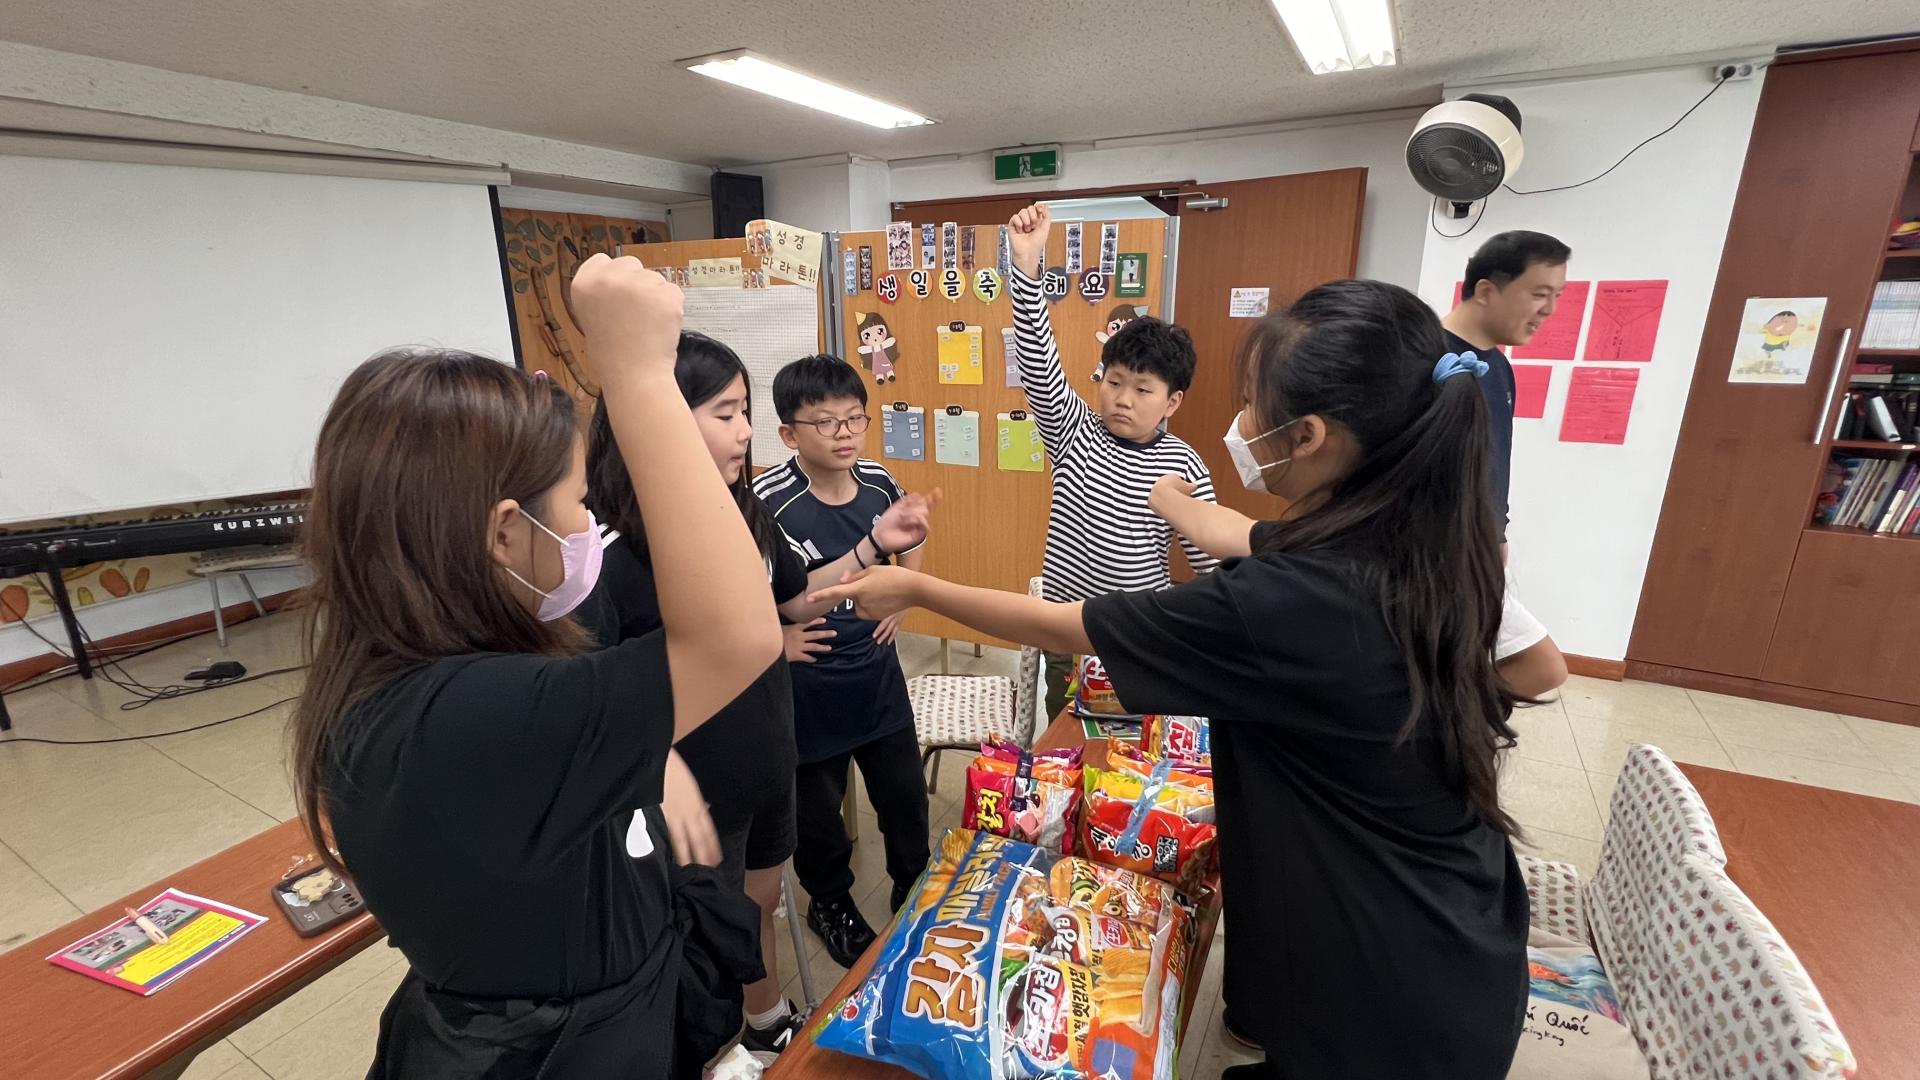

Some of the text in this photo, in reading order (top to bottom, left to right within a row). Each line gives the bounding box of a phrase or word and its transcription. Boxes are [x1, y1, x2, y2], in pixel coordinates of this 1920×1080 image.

[777, 229, 805, 251] 성경
[213, 515, 304, 531] KURZWEI
[977, 788, 1004, 832] 갈치
